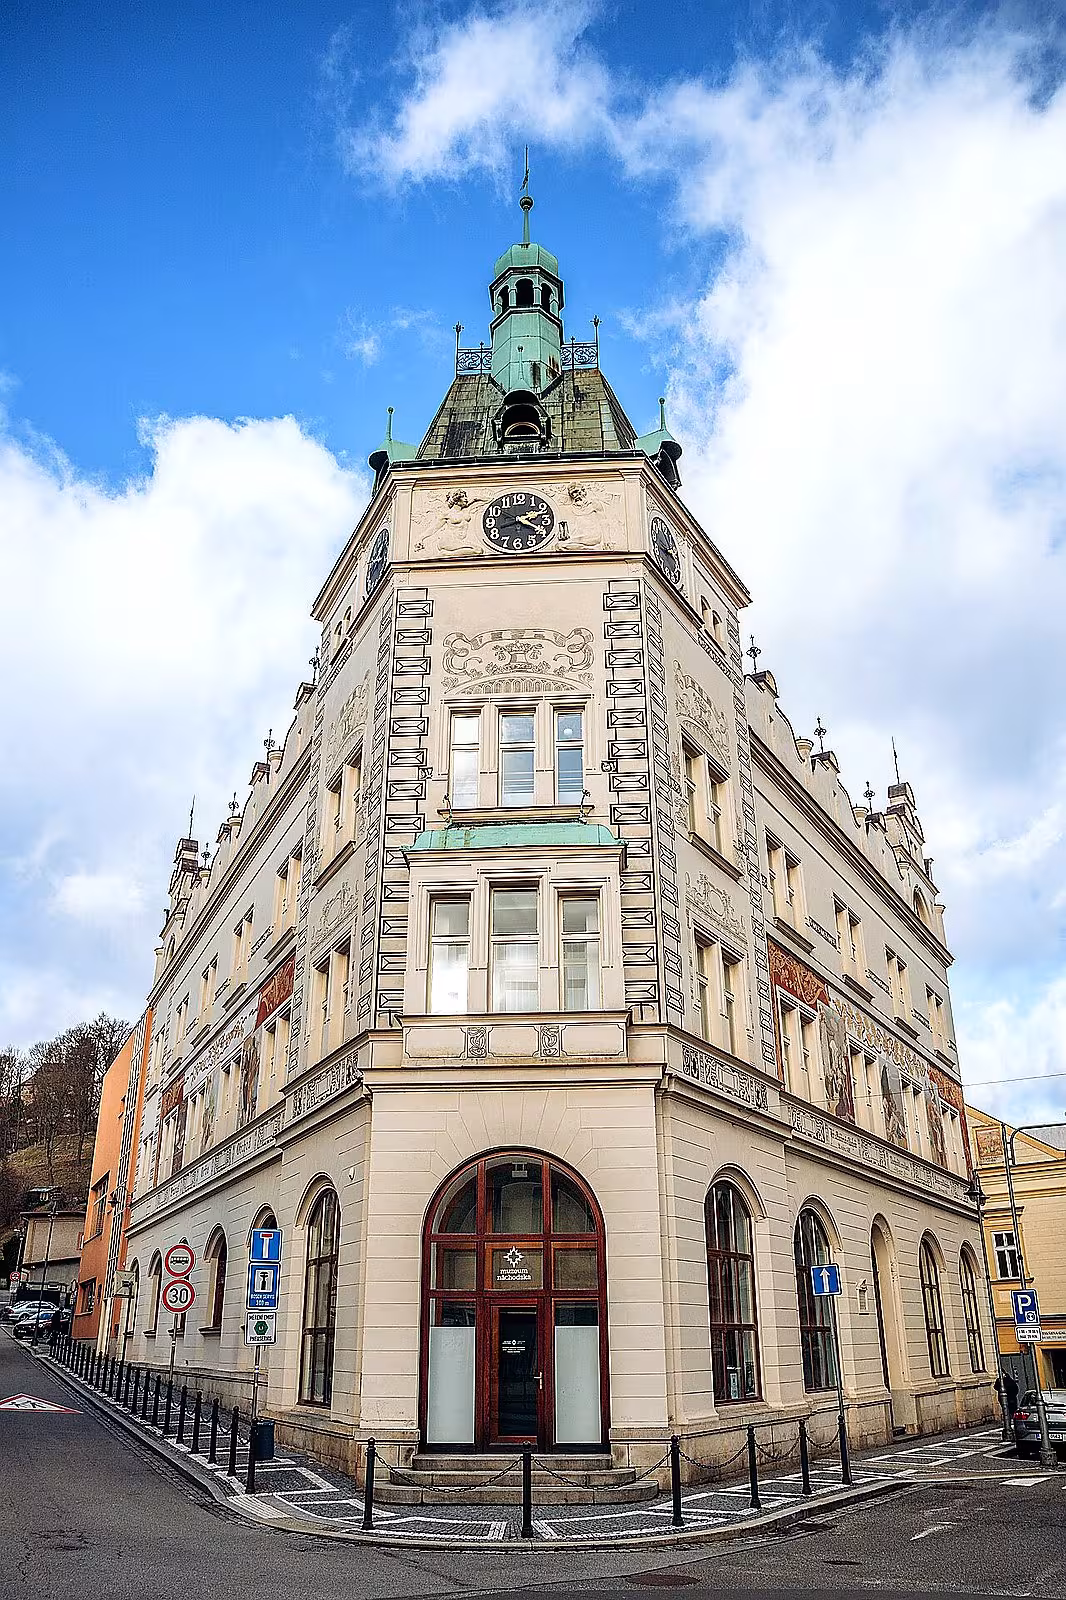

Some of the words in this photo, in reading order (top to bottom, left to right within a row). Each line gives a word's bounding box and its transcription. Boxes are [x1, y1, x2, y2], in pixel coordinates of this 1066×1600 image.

[501, 496, 511, 509] 11
[512, 493, 526, 505] 12
[529, 495, 536, 507] 1
[488, 505, 501, 517] 10
[538, 502, 548, 514] 2
[485, 517, 496, 528] 9
[541, 514, 551, 526] 3
[490, 527, 500, 540] 8
[500, 535, 510, 548] 7
[512, 537, 523, 550] 6
[526, 534, 537, 546] 5
[169, 1287, 189, 1304] 30
[1017, 1294, 1032, 1315] P
